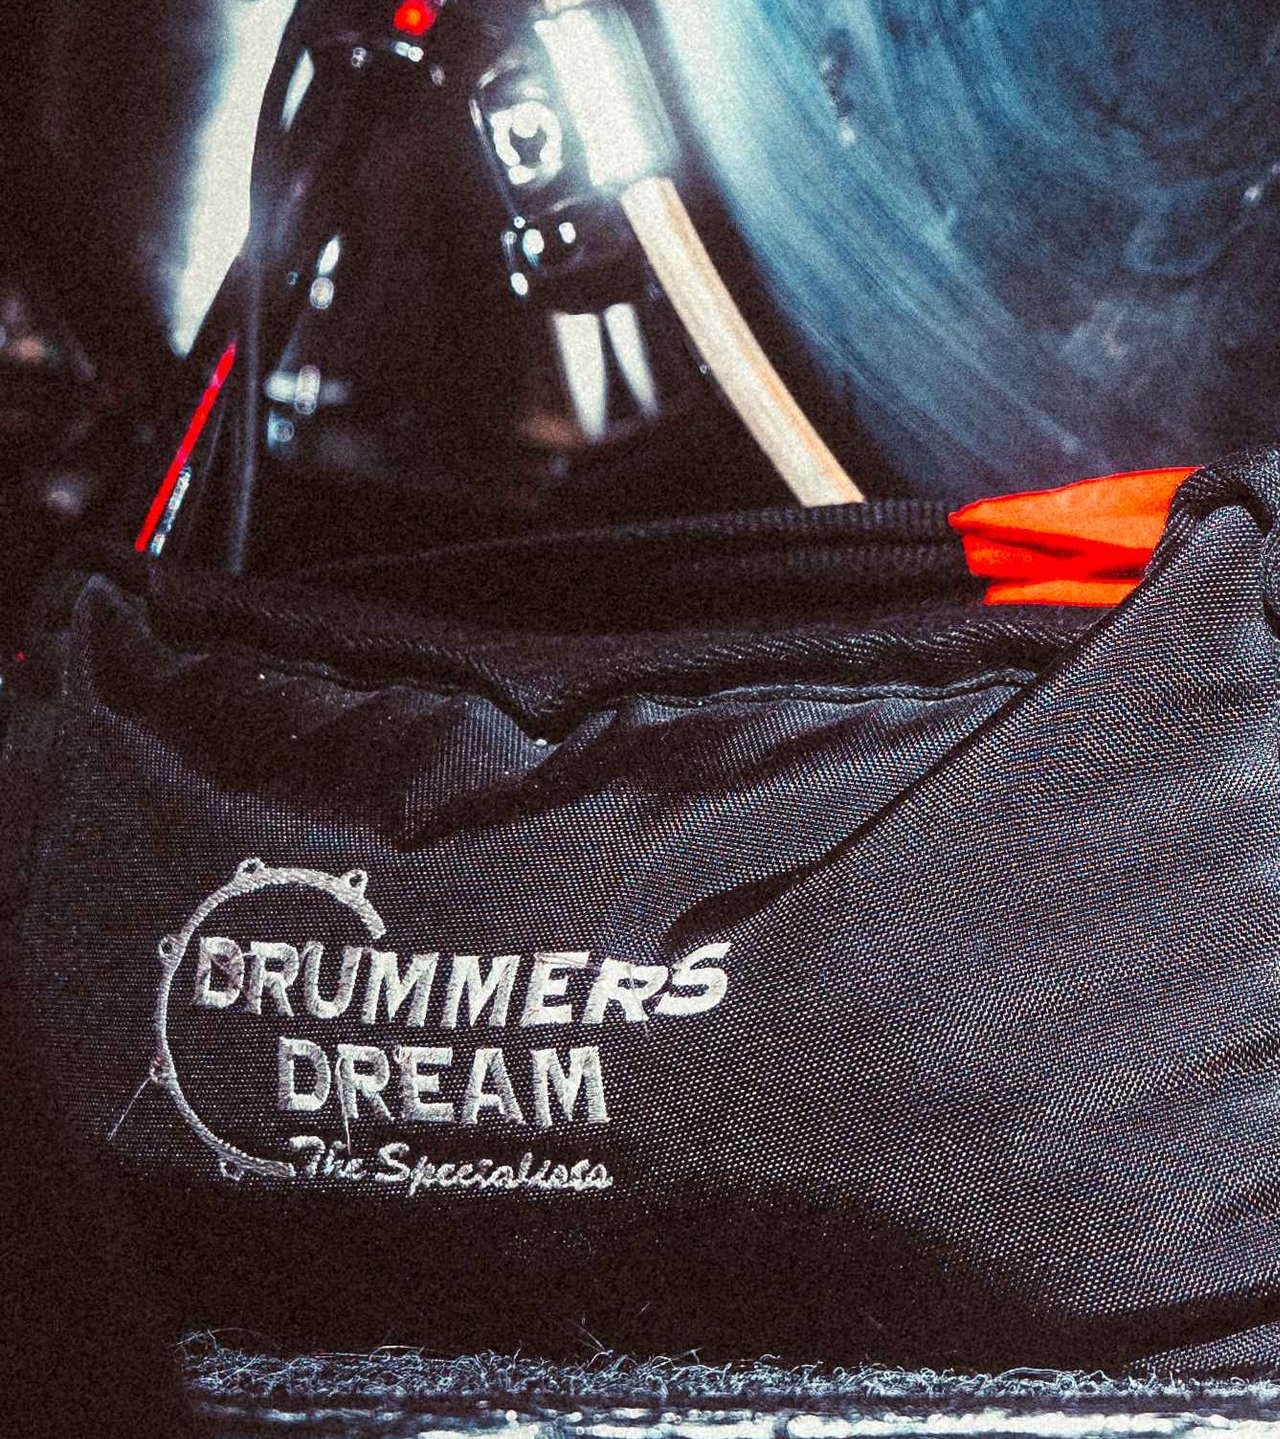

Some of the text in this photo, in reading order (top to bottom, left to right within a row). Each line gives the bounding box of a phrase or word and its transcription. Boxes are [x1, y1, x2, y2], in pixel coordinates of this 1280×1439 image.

[196, 935, 732, 1029] DRUMMERS
[278, 1036, 610, 1125] DREAM
[290, 1134, 364, 1182] The
